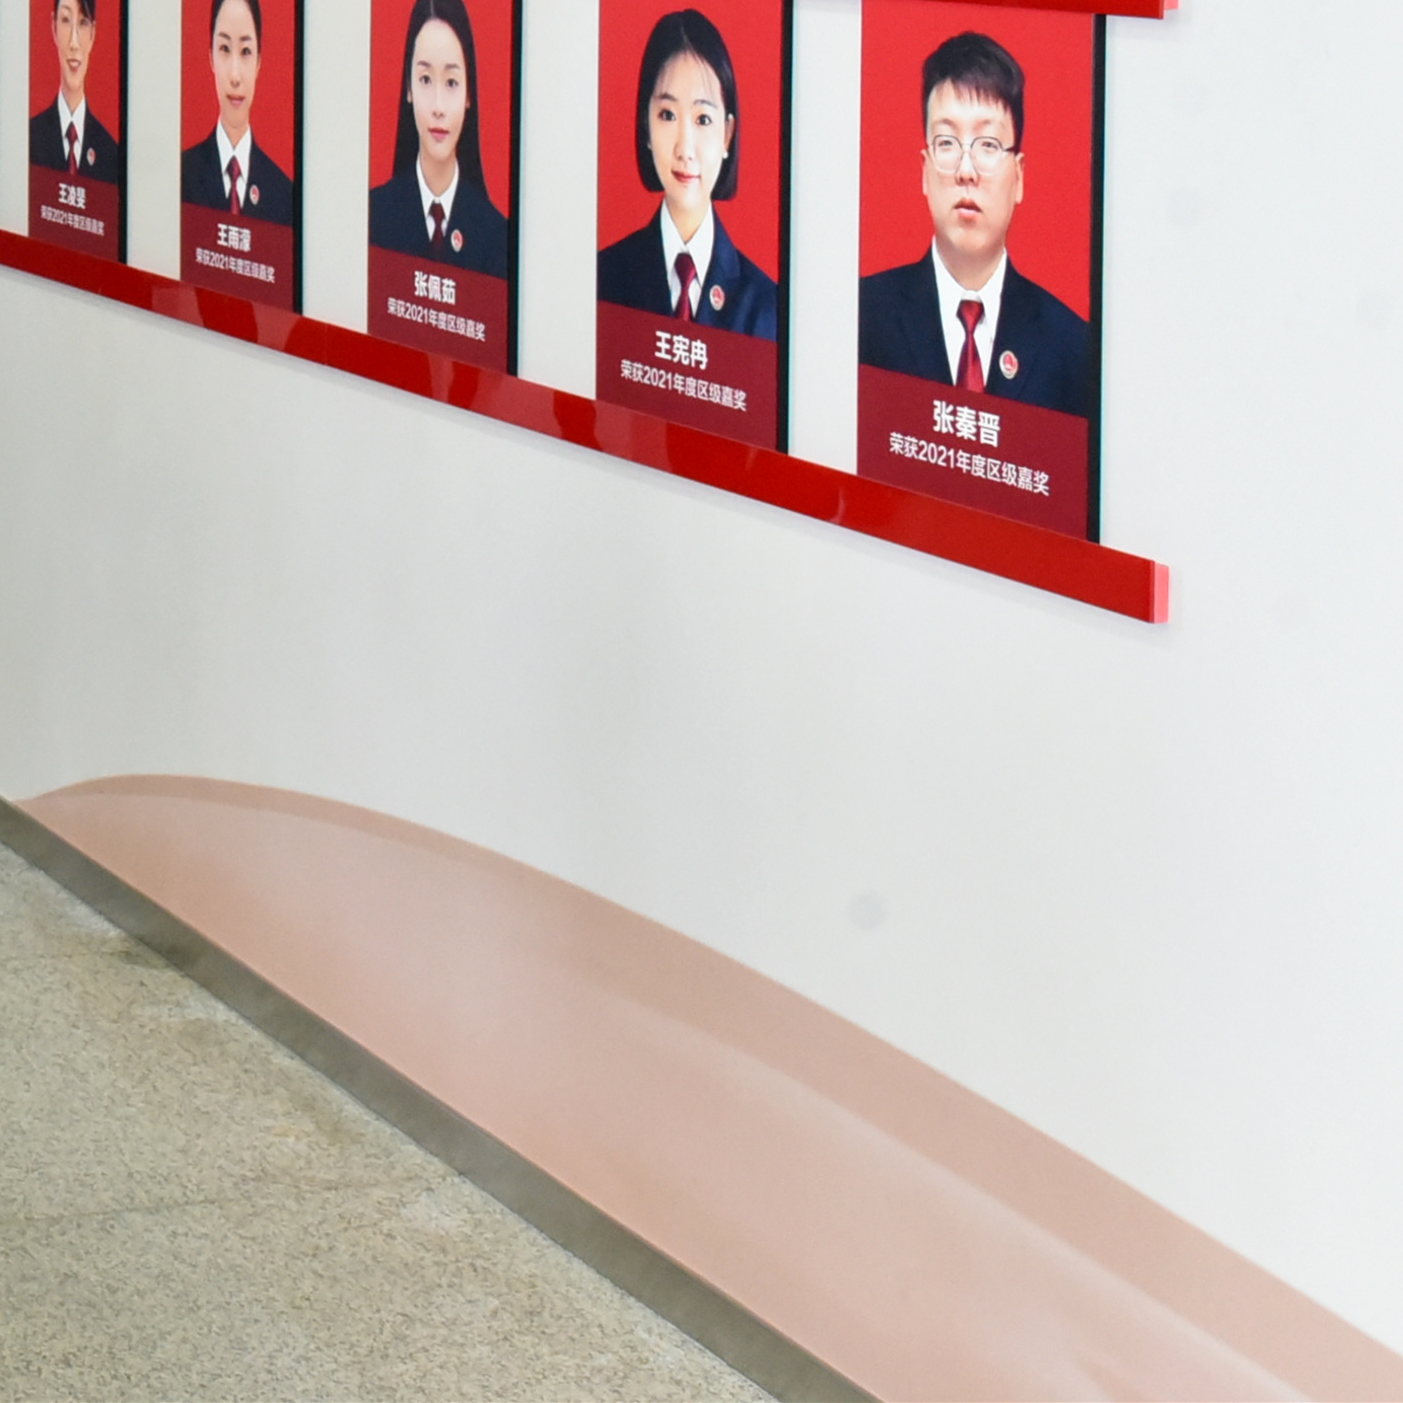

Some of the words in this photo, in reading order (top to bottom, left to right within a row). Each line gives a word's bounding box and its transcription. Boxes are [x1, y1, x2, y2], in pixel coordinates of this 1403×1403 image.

[387, 296, 487, 344] 荣获2021年度区级嘉奖
[654, 330, 708, 370] 王宪冉
[619, 357, 748, 413] 荣获2021年度区级嘉奖
[933, 399, 1001, 449] 张秦晋
[889, 431, 1050, 497] 荣获2021年度区级嘉奖
